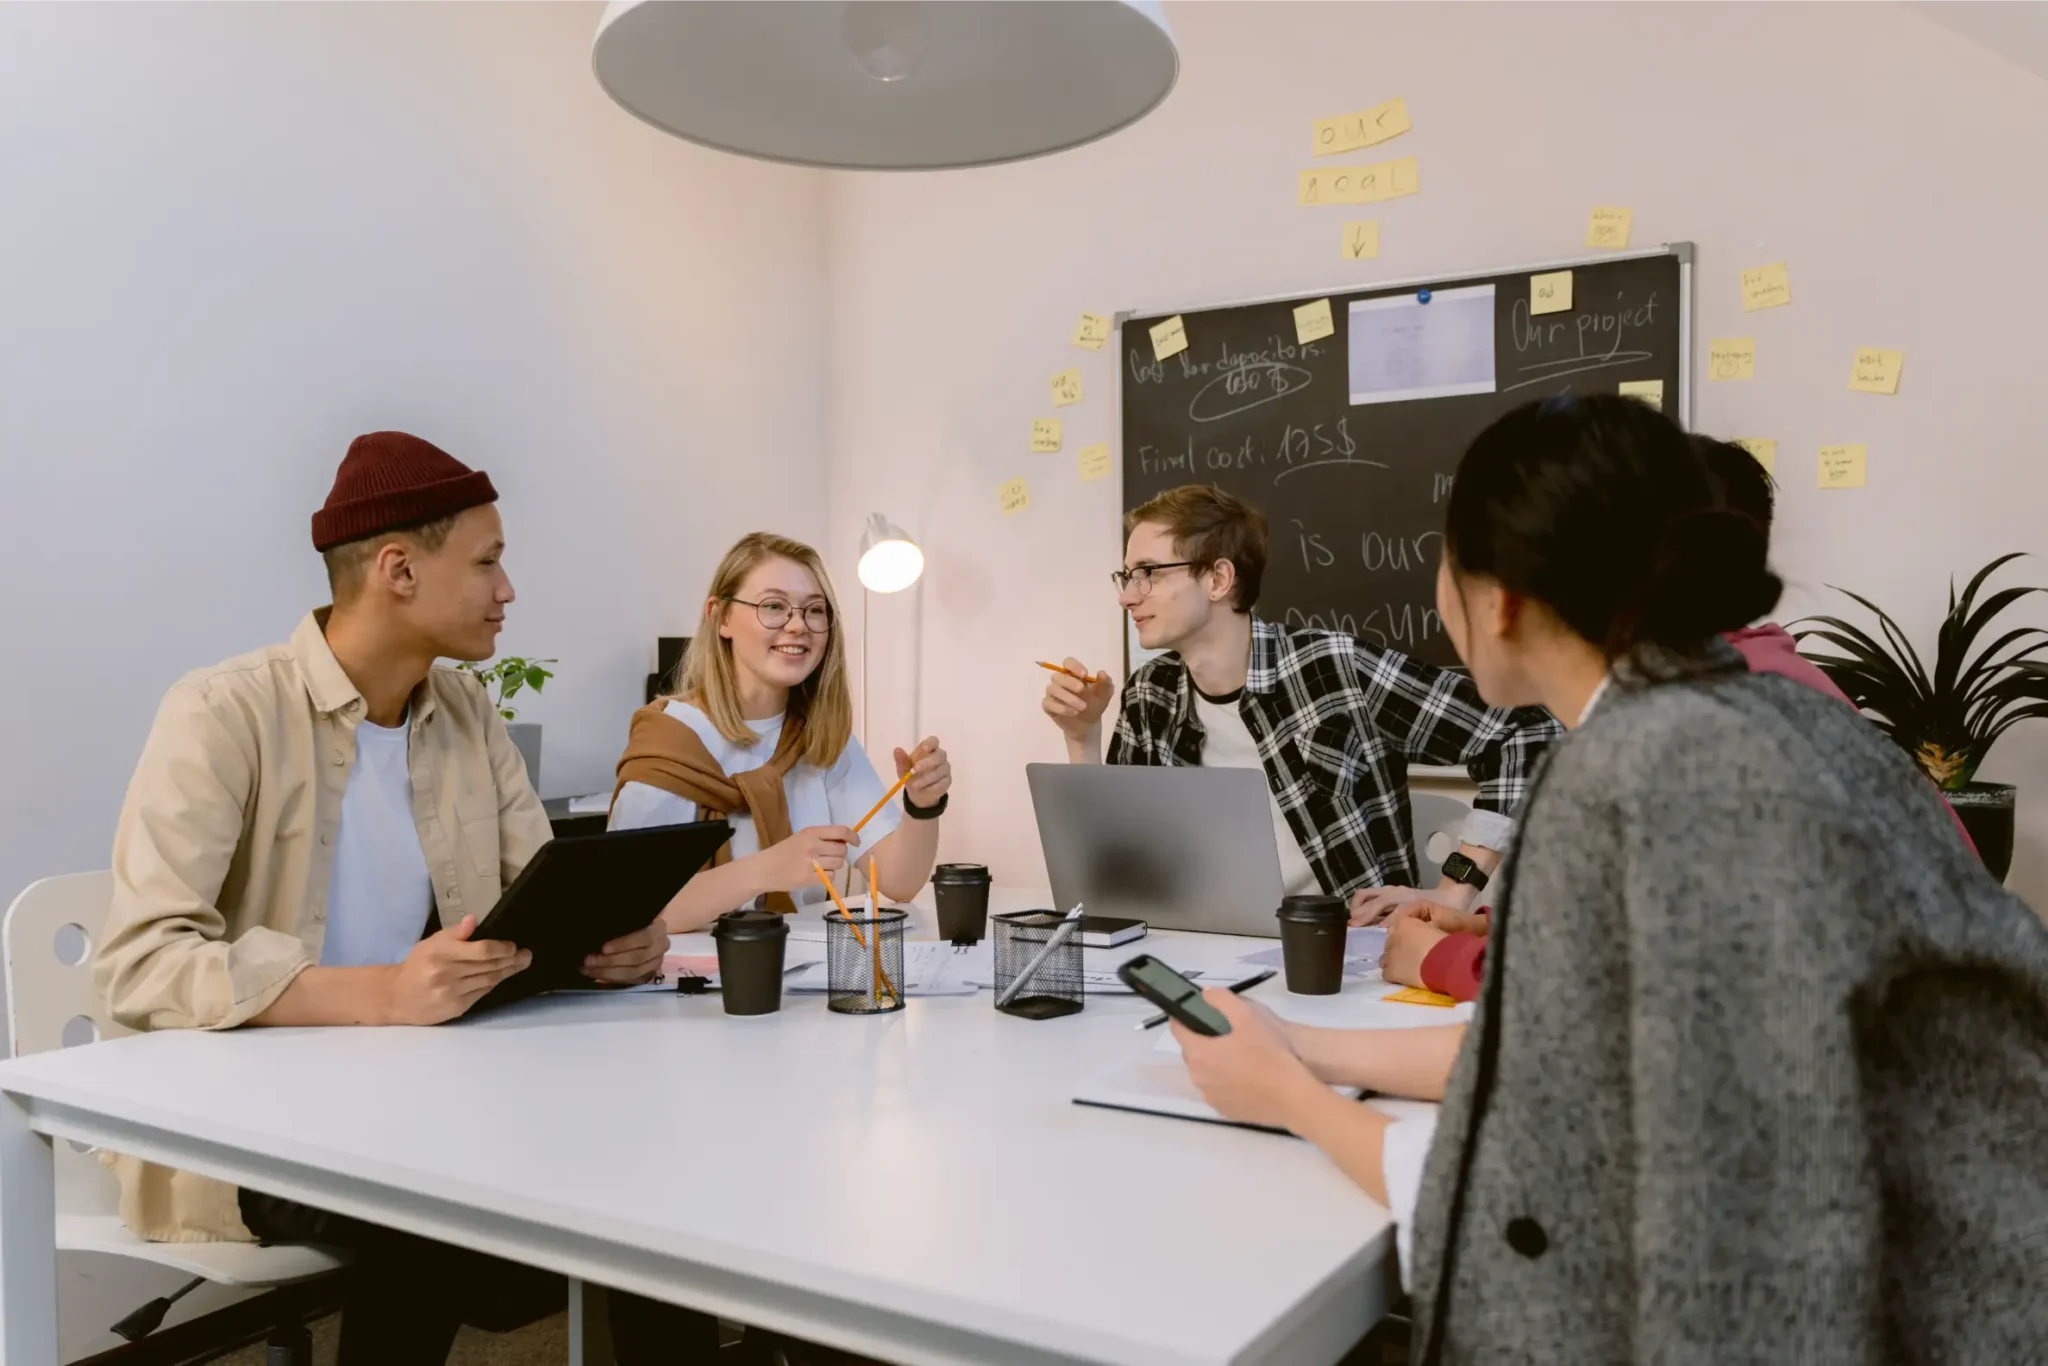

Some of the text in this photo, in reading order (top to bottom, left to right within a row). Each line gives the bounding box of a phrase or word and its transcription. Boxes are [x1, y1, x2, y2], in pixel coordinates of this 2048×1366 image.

[1511, 290, 1660, 361] Our project
[1139, 434, 1195, 475] Final
[1291, 518, 1334, 573] is
